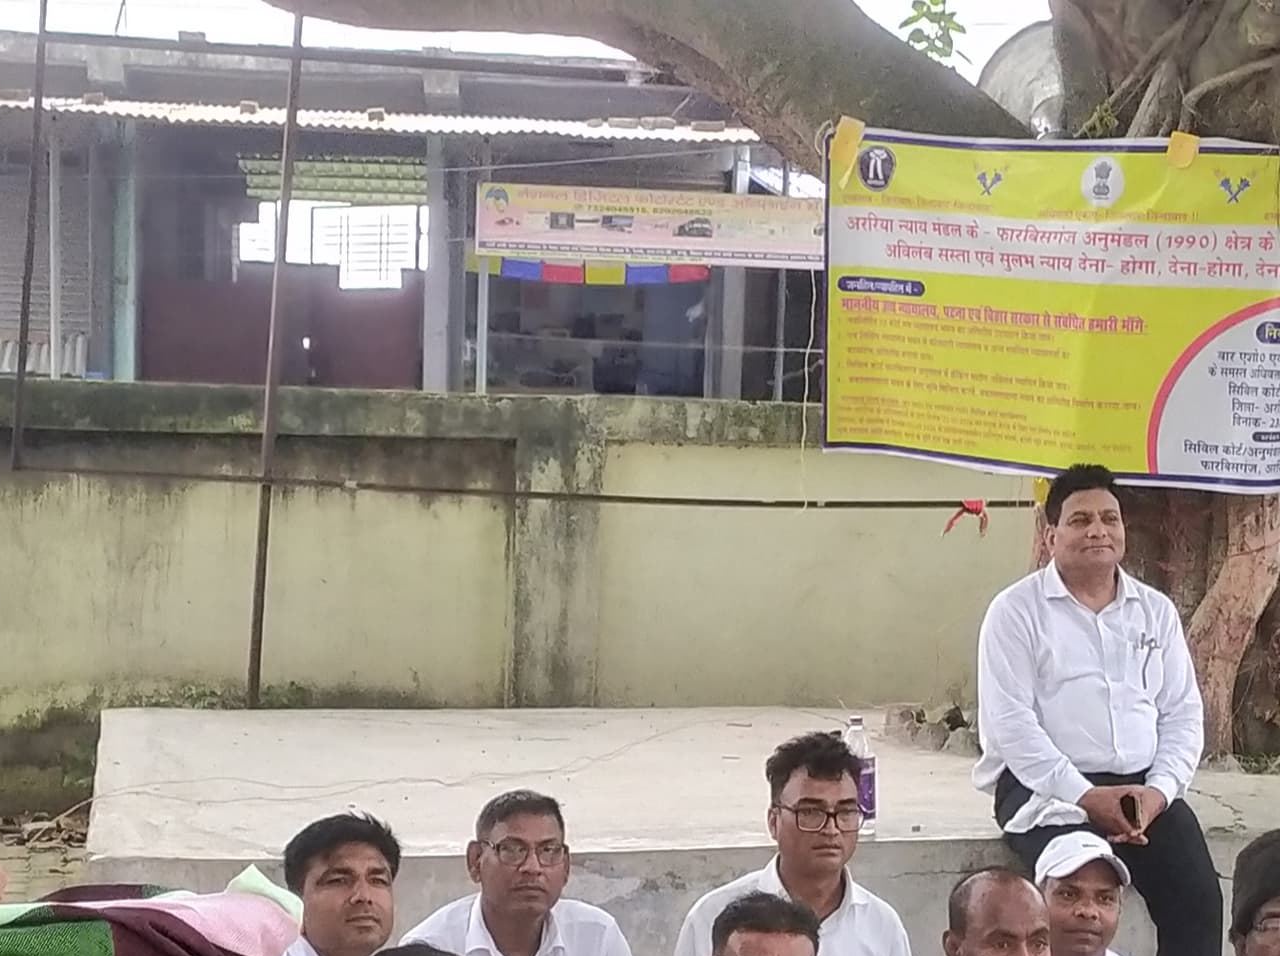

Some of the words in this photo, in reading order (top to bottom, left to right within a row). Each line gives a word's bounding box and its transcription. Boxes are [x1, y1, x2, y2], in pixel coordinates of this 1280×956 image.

[847, 212, 893, 233] अररिया
[898, 218, 928, 235] न्याय
[932, 216, 962, 239] मंडल
[965, 220, 980, 239] के
[996, 224, 1076, 246] फारबिसगंज
[1082, 226, 1149, 252] अनुमंडल
[1156, 230, 1218, 252] (1990)
[1224, 230, 1252, 252] क्षेत्र
[1258, 231, 1275, 251] के
[885, 239, 933, 260] अविलंब
[938, 246, 971, 264] सस्ता
[975, 246, 995, 267] एवं
[999, 252, 1035, 273] सुलभ
[1039, 256, 1074, 273] न्याय
